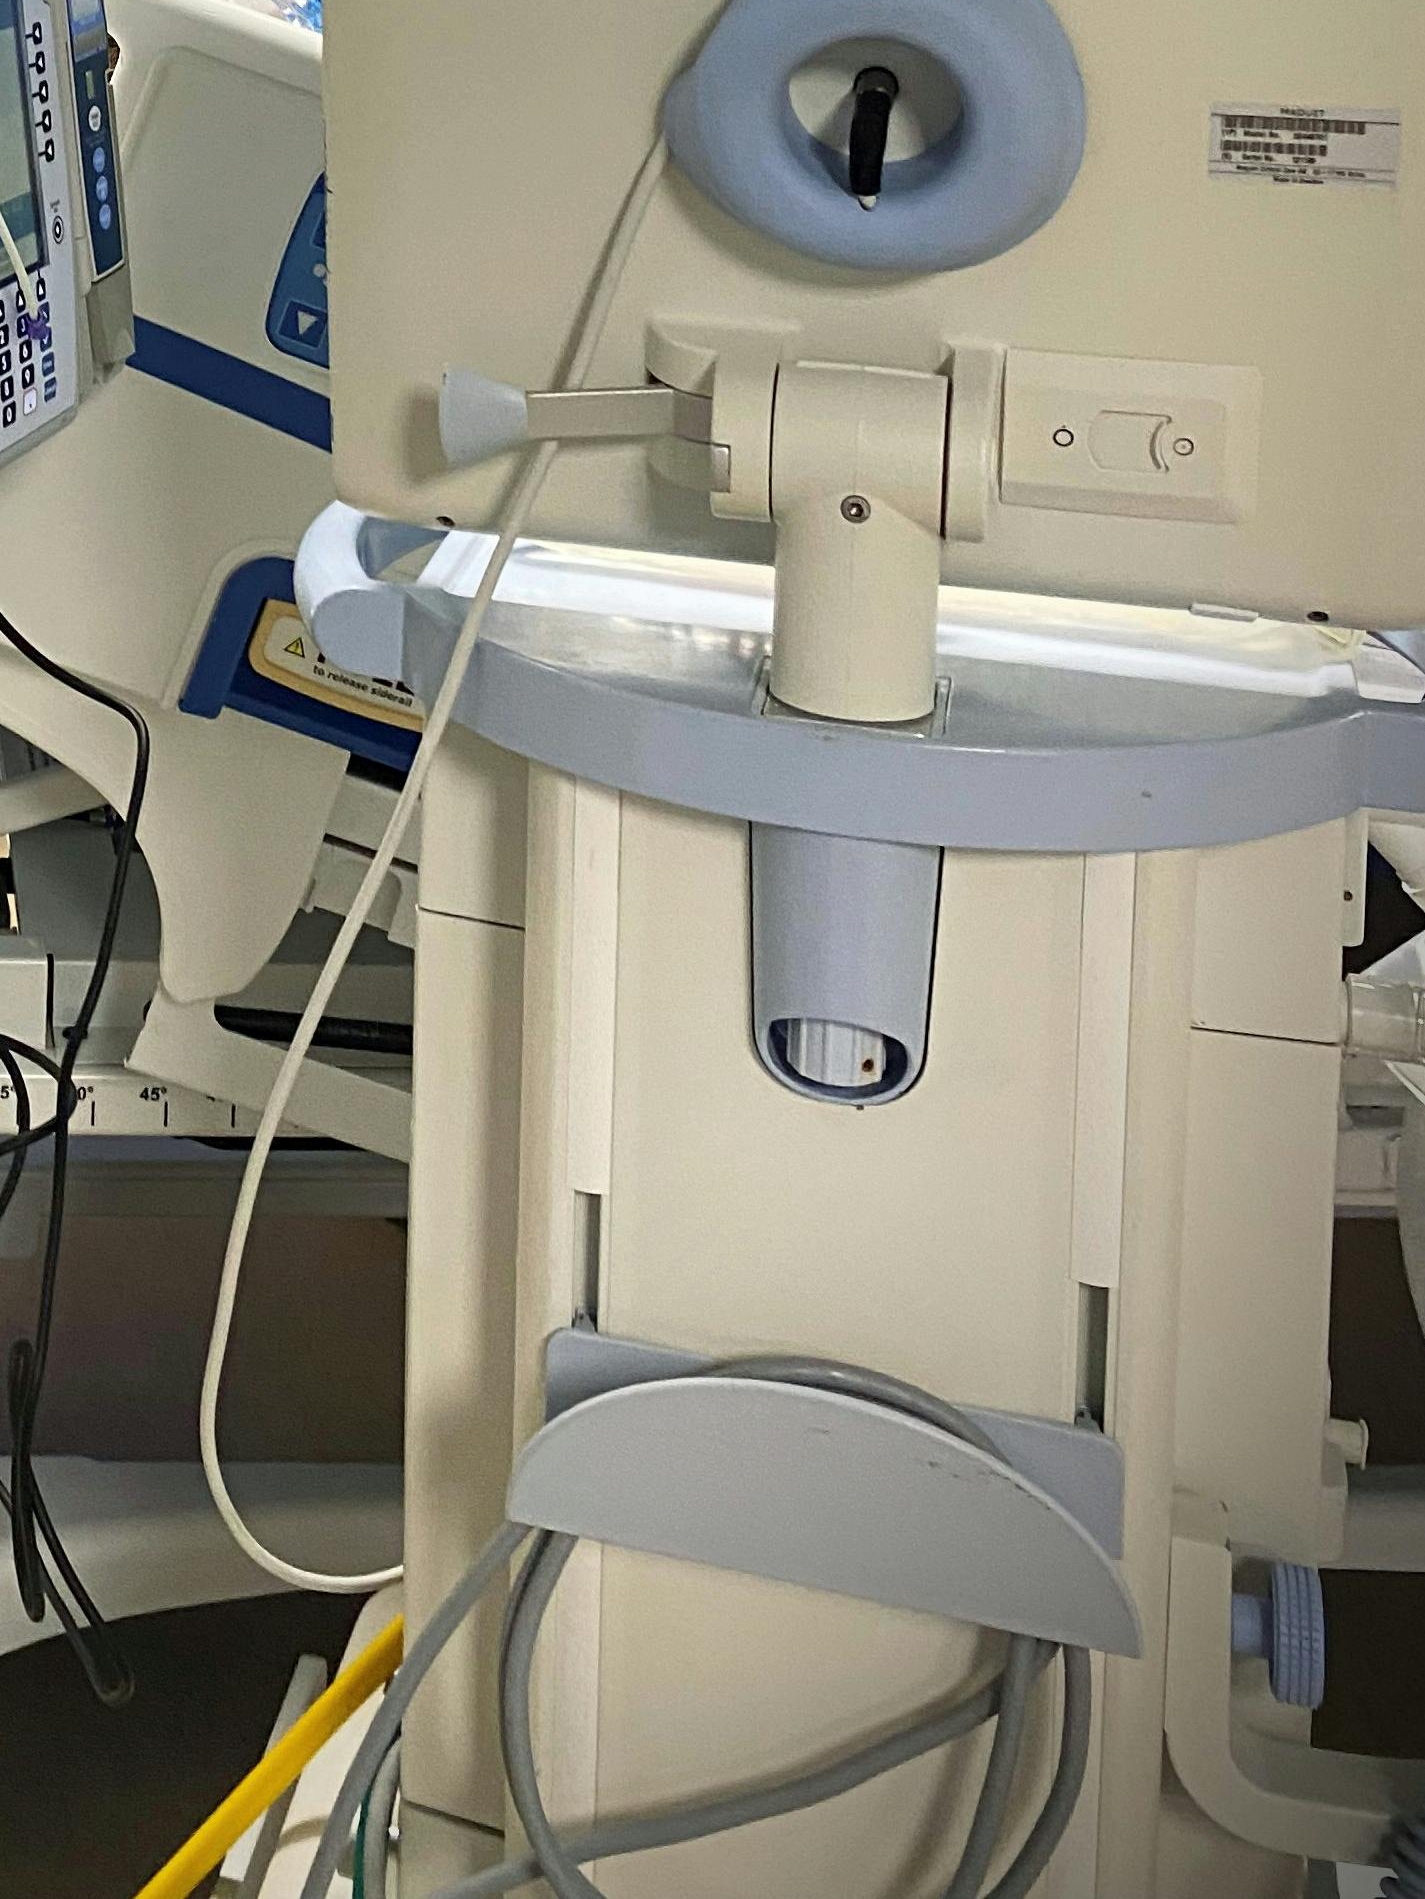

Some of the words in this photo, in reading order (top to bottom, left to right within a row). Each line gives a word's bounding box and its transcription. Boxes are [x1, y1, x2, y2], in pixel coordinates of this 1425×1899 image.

[313, 664, 325, 676] to
[327, 671, 369, 692] release
[370, 686, 414, 708] siderail
[76, 1086, 95, 1101] 0°
[139, 1086, 168, 1101] 45°
